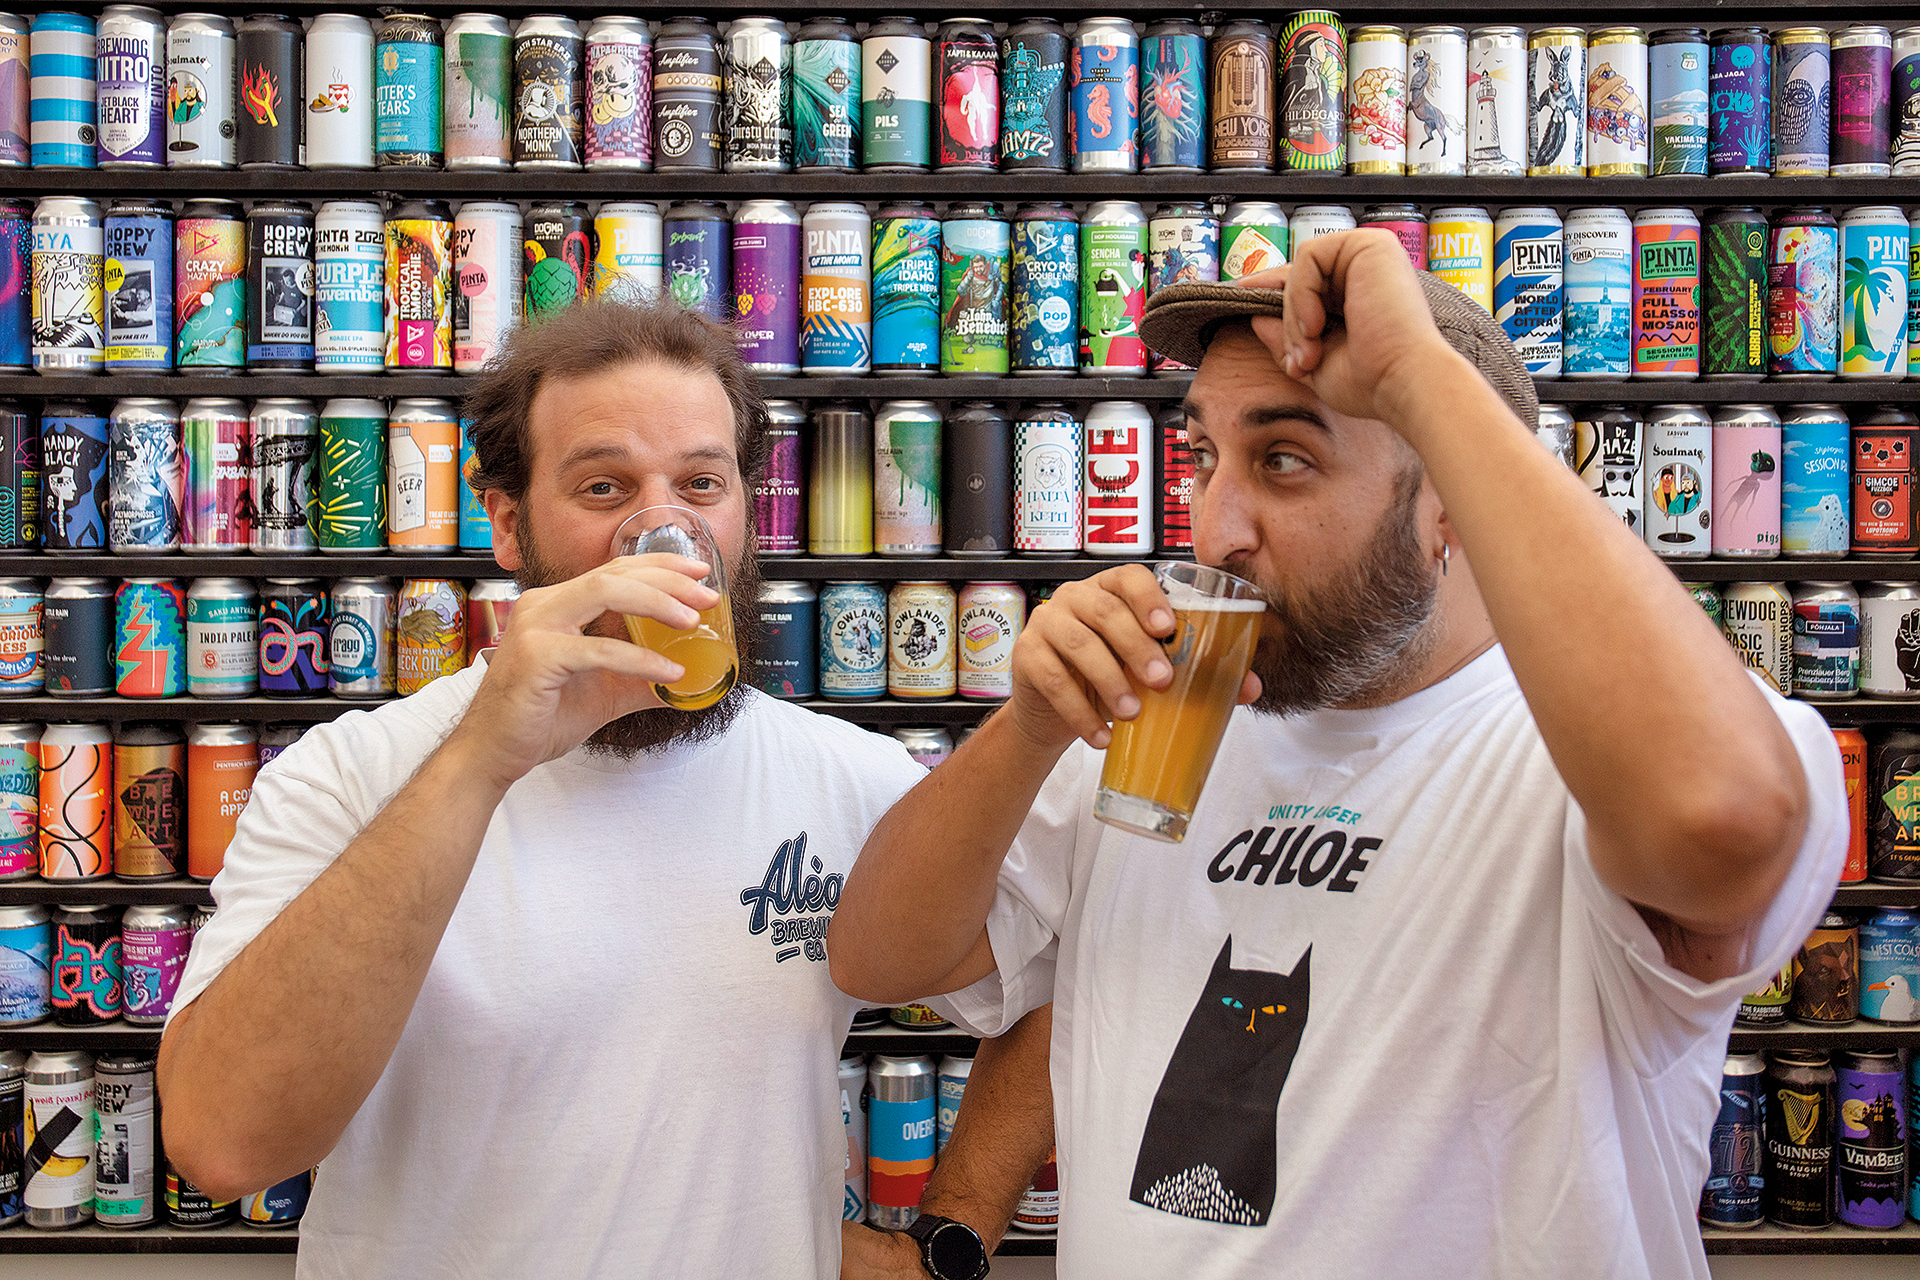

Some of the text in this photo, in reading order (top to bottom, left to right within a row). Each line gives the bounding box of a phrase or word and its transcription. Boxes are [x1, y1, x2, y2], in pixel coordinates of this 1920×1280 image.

[532, 38, 553, 48] STAR
[658, 53, 699, 68] Amplifier
[98, 56, 149, 83] NITRO
[150, 65, 163, 98] INTO
[112, 97, 139, 108] BLACK
[378, 101, 411, 116] TEARS
[101, 108, 139, 125] HEART
[658, 104, 698, 119] Amplifier
[829, 105, 847, 118] SEA
[1285, 110, 1345, 121] HILDEGARD
[875, 115, 899, 128] PILS
[1214, 117, 1271, 137] NEW YORK
[518, 127, 562, 140] NORTHERN
[822, 123, 852, 138] GREEN
[525, 140, 552, 153] MONK
[1216, 138, 1269, 149] MOCACCINO
[1665, 136, 1695, 144] YAKIMA
[107, 227, 156, 243] HOPPY
[264, 224, 314, 241] HOPPY
[534, 223, 564, 235] DOGMA
[1397, 230, 1421, 240] Double
[1573, 231, 1619, 239] DISCOVERY
[32, 233, 73, 250] DEYA
[354, 230, 385, 245] 2020
[807, 230, 863, 255] PINTA
[107, 242, 149, 257] CREW
[263, 240, 309, 257] CREW
[1429, 233, 1483, 258] PINTA
[1091, 248, 1121, 259] SENCHA
[1515, 244, 1562, 265] PINTA
[1572, 250, 1593, 260] PINTA
[1643, 246, 1695, 268] PINTA
[186, 261, 226, 272] CRAZY
[811, 255, 860, 266] OF THE MONTH
[900, 260, 934, 271] TRIPLE
[1027, 261, 1078, 272] CRYO POP
[1431, 259, 1480, 270] OF THE MONTH
[187, 272, 224, 281] HAZY IPA
[316, 262, 384, 285] PURPLE
[461, 273, 486, 287] PINTA
[898, 270, 935, 282] IDAHO
[1029, 273, 1062, 281] DOUBLE
[400, 260, 411, 320] TROPICAL
[411, 252, 422, 321] SMOOTHIE
[893, 283, 919, 292] TRIPLE
[1643, 286, 1692, 294] FEBRUARY
[808, 287, 862, 300] EXPLORE
[1514, 295, 1559, 305] WORLD
[807, 300, 863, 313] HBC-630
[1642, 298, 1678, 308] FULL
[1043, 312, 1068, 321] POP
[1514, 307, 1556, 316] AFTER
[1642, 310, 1699, 319] GLASS OF
[744, 330, 775, 340] OVER
[1646, 347, 1682, 355] SESSION
[1749, 329, 1761, 366] SABRO
[1652, 444, 1704, 457] Soulmate
[45, 451, 81, 467] BLACK
[1804, 458, 1840, 474] SESSION
[397, 478, 423, 494] BEER
[1088, 427, 1140, 544] NICE
[1093, 475, 1132, 485] MILKSHAKE
[1866, 477, 1899, 487] SIMCOE
[1097, 485, 1127, 494] VANILLA
[1102, 494, 1120, 504] DIPA
[1756, 531, 1779, 545] pigs
[208, 608, 229, 618] SAKU
[777, 613, 793, 621] RAIN
[835, 609, 886, 637] LOWLANDER
[893, 608, 946, 637] LOWLANDER
[960, 608, 1011, 637] LOWLANDER
[1810, 623, 1840, 631] PÕHJALA
[199, 631, 251, 644] INDIA PALE
[1780, 600, 1789, 692] BRINGING HOPS
[61, 654, 77, 663] drop
[422, 656, 443, 672] OIL
[842, 656, 882, 668] WHITE ALE
[962, 653, 1005, 667] TOMPOUCE ALE
[1797, 668, 1851, 678] Prenzlauer Berg
[130, 781, 173, 799] BRE
[220, 790, 230, 802] A
[129, 803, 173, 819] WHE
[1268, 804, 1362, 826] UNITY LAGER
[130, 823, 173, 840] ART
[1207, 825, 1383, 891] CHLOE
[136, 945, 162, 956] NOT FLAT
[1769, 1139, 1831, 1160] GUINNESS
[1776, 1161, 1824, 1174] DRAUGHT
[1789, 1171, 1810, 1179] STOUT
